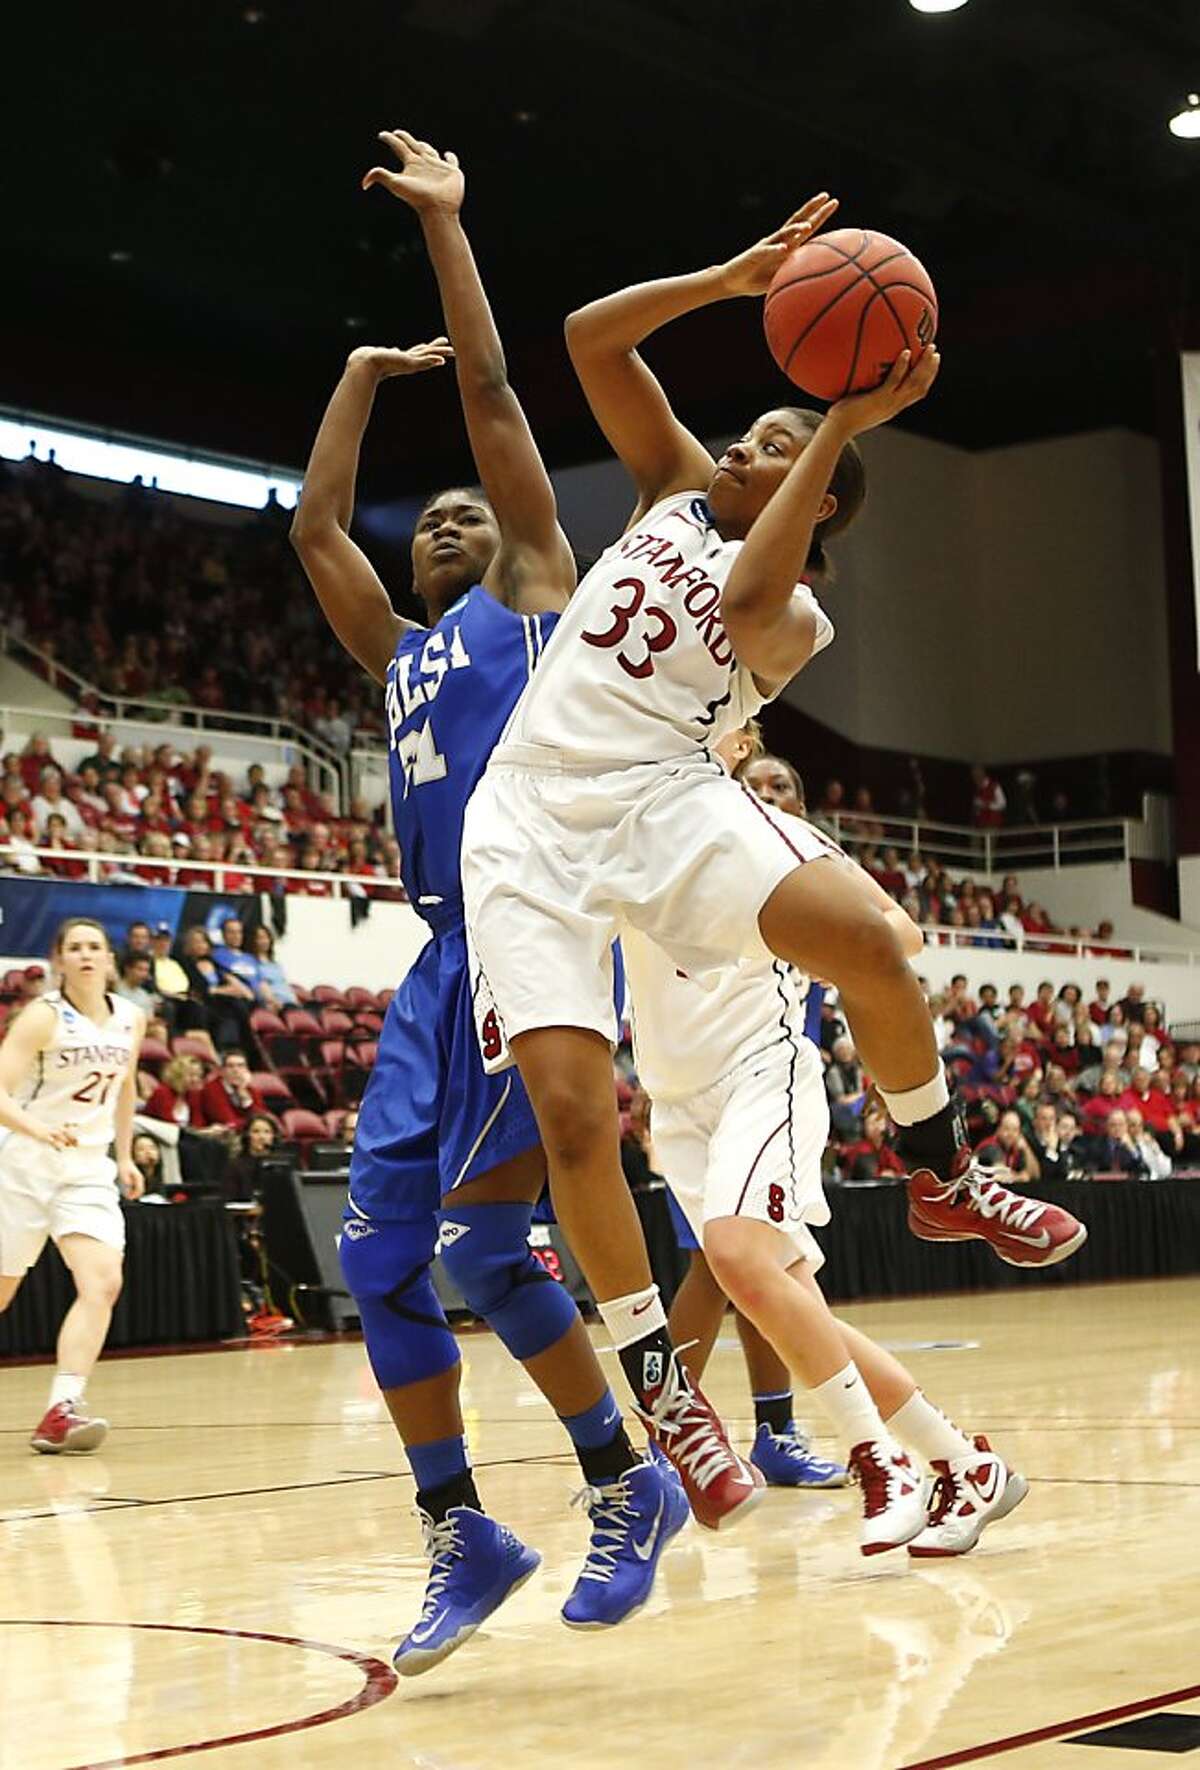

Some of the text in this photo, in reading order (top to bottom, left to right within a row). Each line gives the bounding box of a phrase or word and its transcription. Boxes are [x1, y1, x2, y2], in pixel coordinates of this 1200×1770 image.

[580, 577, 677, 679] 33
[621, 534, 734, 667] TANFORD
[72, 1072, 116, 1104] 21
